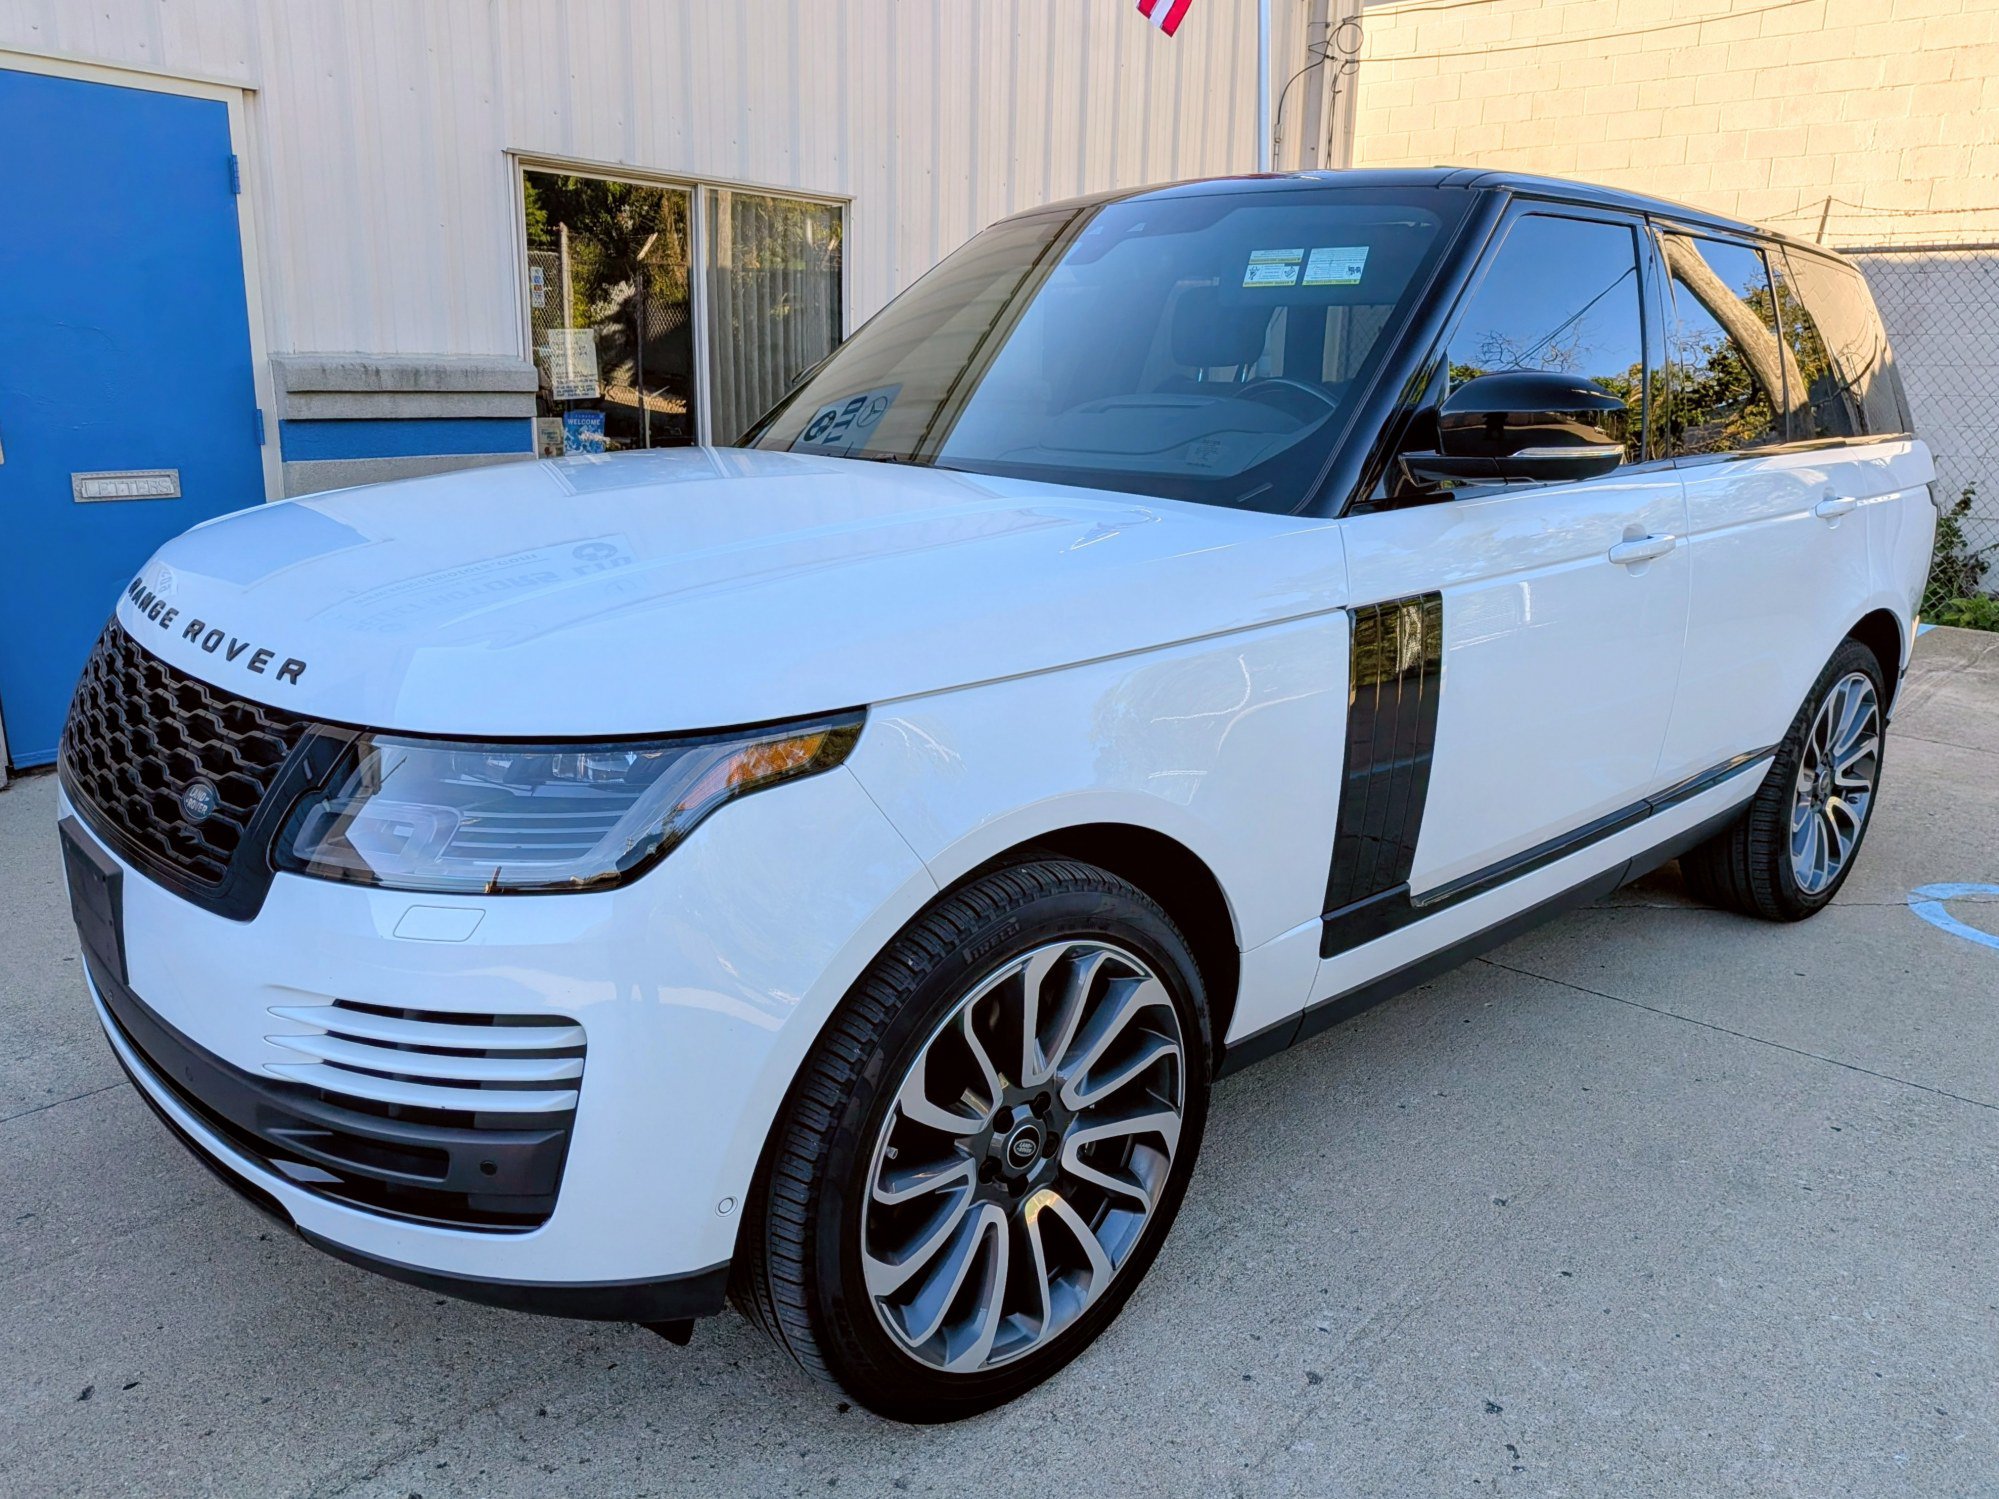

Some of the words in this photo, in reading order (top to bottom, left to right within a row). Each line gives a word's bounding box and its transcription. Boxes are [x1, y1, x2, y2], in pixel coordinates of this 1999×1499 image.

[567, 418, 601, 426] WELCOME
[84, 478, 172, 497] LETTERS
[127, 576, 180, 630] RANGE
[181, 618, 307, 686] ROVER
[189, 786, 207, 802] LAND
[186, 798, 208, 815] ROVER
[962, 915, 1020, 965] PIRELLI
